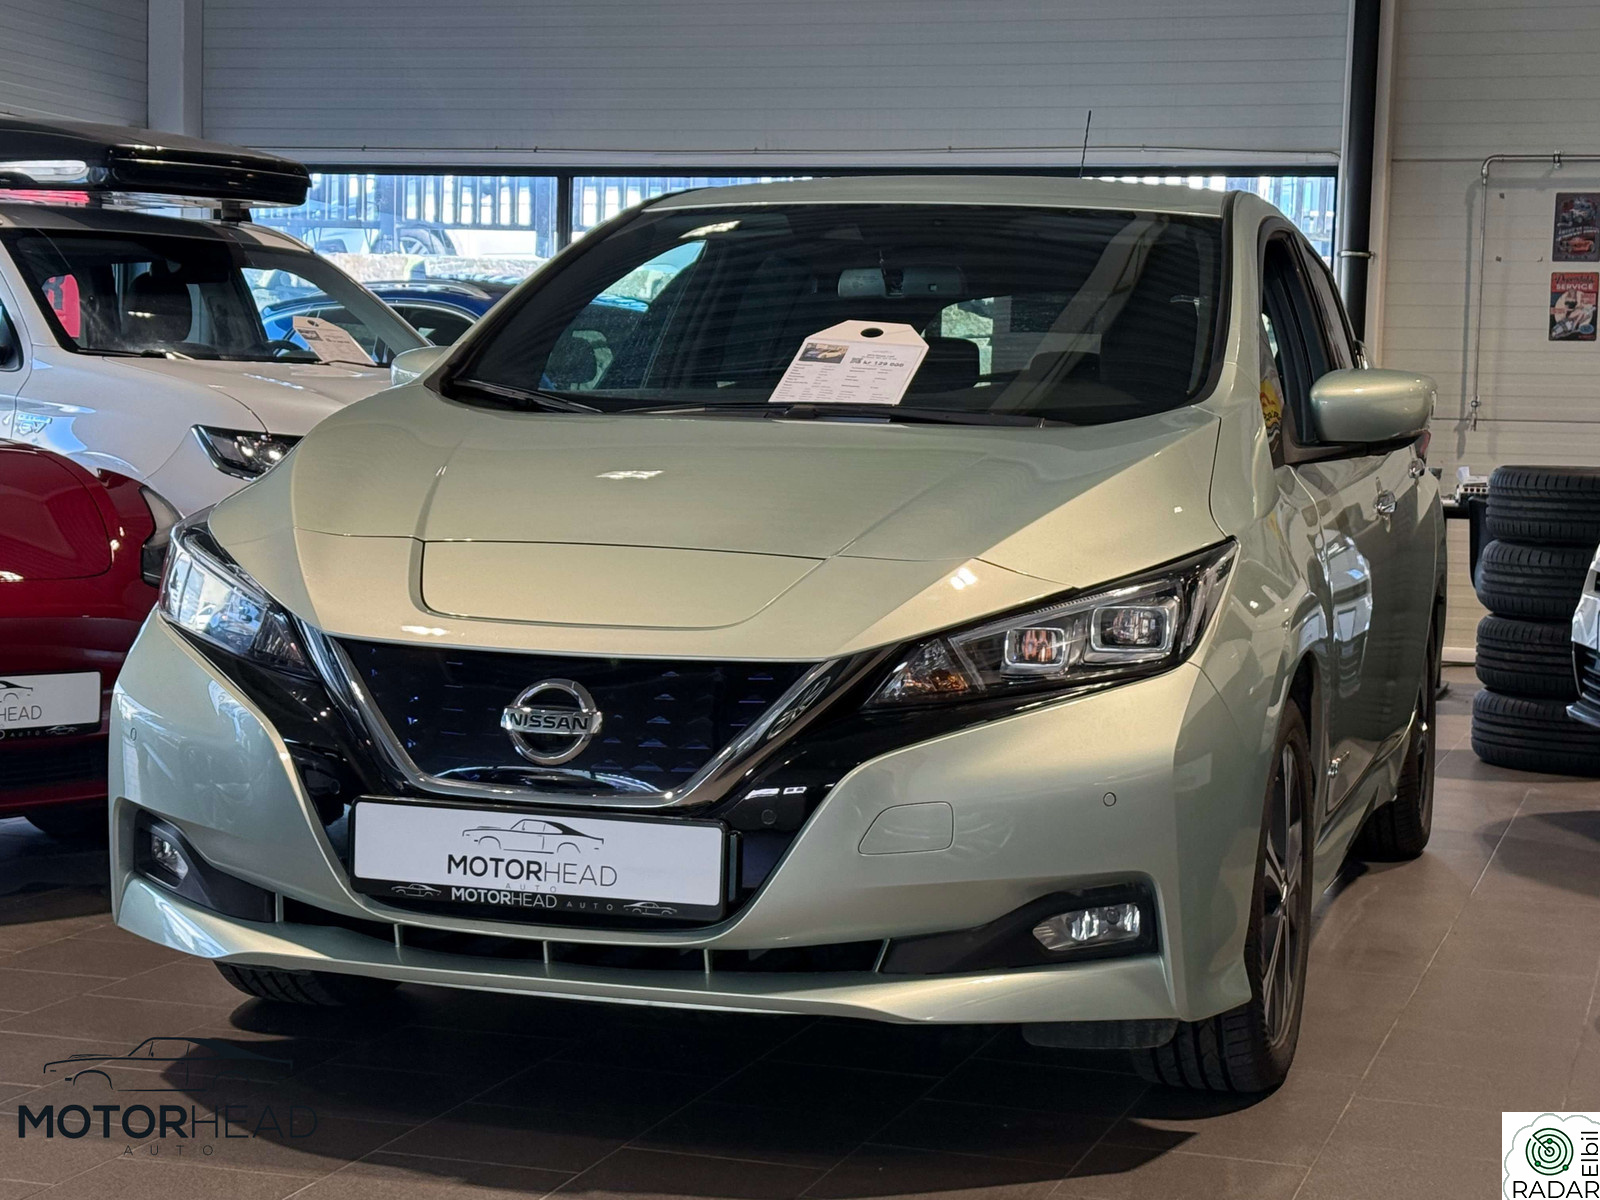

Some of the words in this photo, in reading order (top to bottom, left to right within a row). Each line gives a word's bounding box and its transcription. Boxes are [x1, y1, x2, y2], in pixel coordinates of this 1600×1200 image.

[510, 713, 589, 730] NISSAN
[447, 854, 618, 887] MOTORHEAD
[505, 882, 557, 892] AUTO
[451, 887, 557, 909] MOTORHEAD
[566, 900, 613, 911] AUTO
